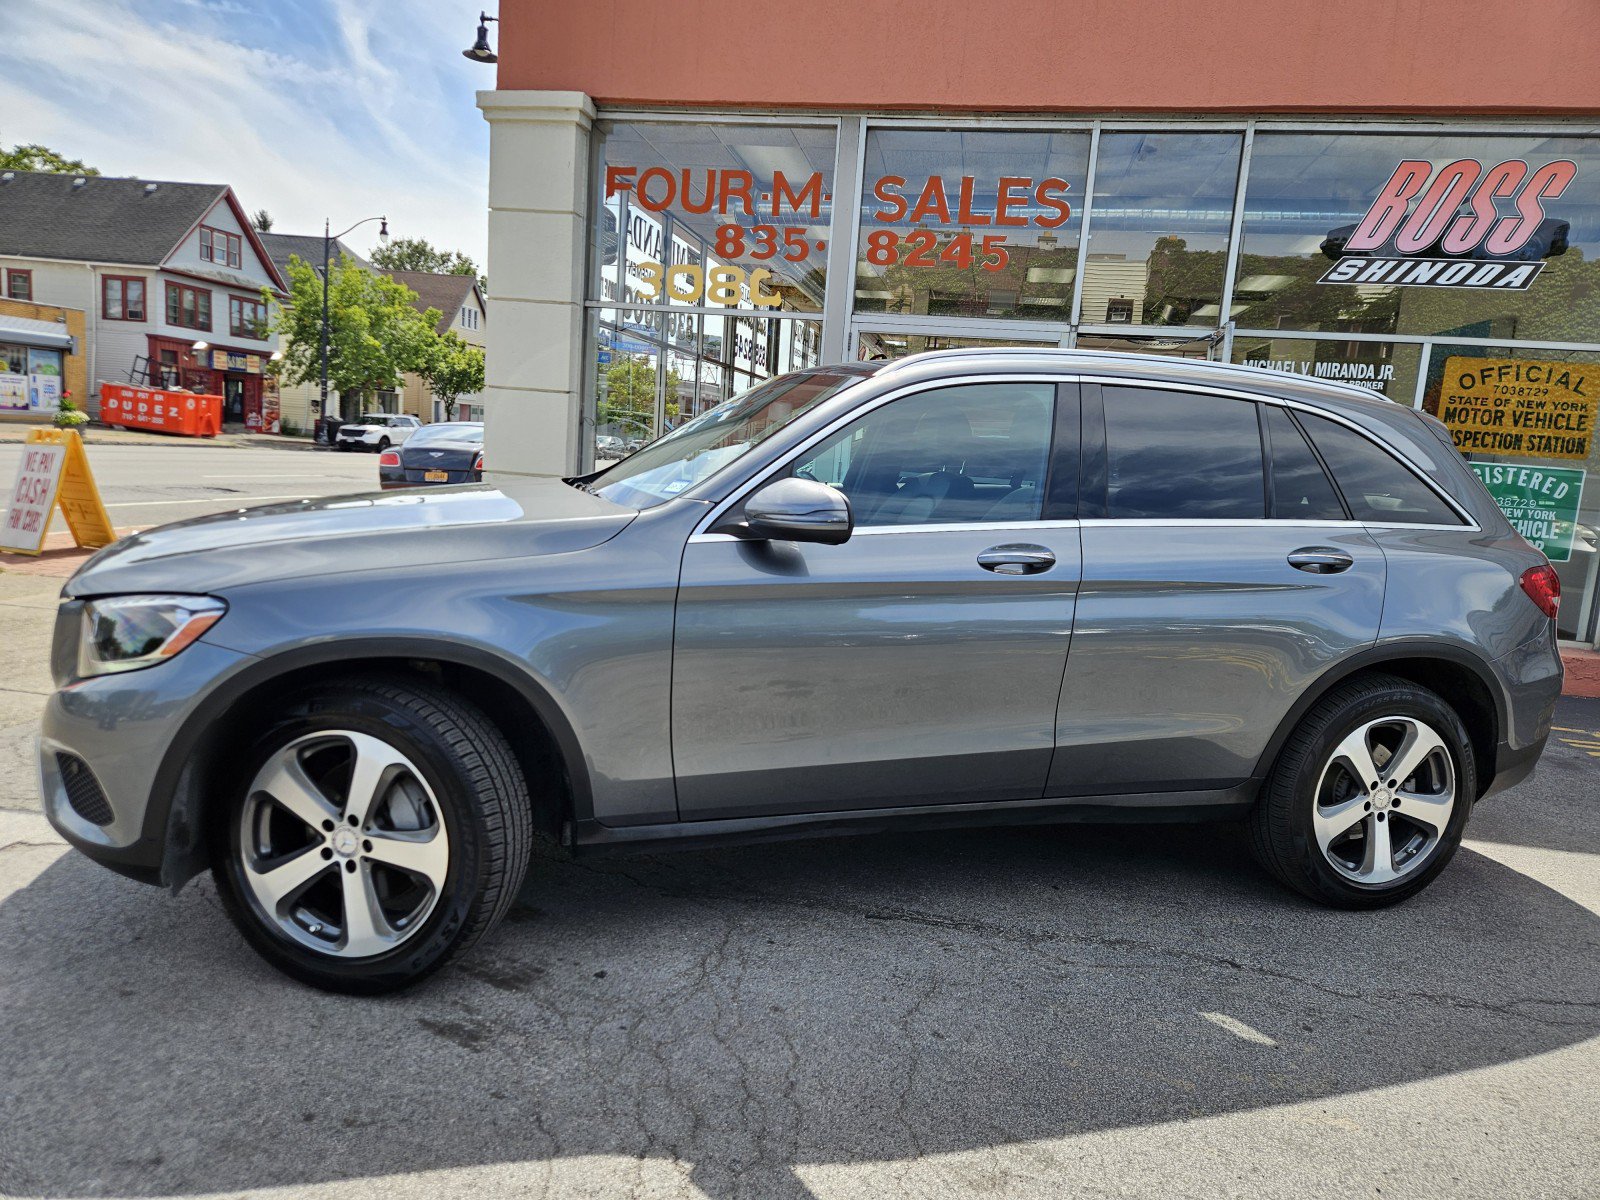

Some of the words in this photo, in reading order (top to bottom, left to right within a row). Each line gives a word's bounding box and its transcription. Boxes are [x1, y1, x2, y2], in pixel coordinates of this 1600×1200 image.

[873, 175, 1071, 229] SALES
[1342, 159, 1578, 256] BOSS
[866, 229, 1010, 273] 8245
[1327, 259, 1536, 287] SHINODA
[1314, 361, 1376, 379] MIRANDA
[1377, 364, 1397, 381] JR.
[1459, 364, 1586, 397] OFFICIAL
[1448, 395, 1488, 406] STATE
[1494, 398, 1512, 407] OF
[1516, 399, 1546, 410] NEW
[1552, 401, 1589, 412] YORK
[1493, 385, 1549, 397] 7038729
[1443, 407, 1505, 426] MOTOR
[1512, 410, 1589, 431] VEHICLE
[1450, 430, 1523, 450] SPECTION
[1526, 434, 1587, 455] STATION
[15, 476, 51, 506] CASH
[1473, 466, 1569, 499] ISTERED
[1496, 496, 1537, 508] 38729
[1500, 507, 1524, 518] NEW
[1528, 509, 1557, 520] YORK
[1509, 519, 1559, 540] EHICLE
